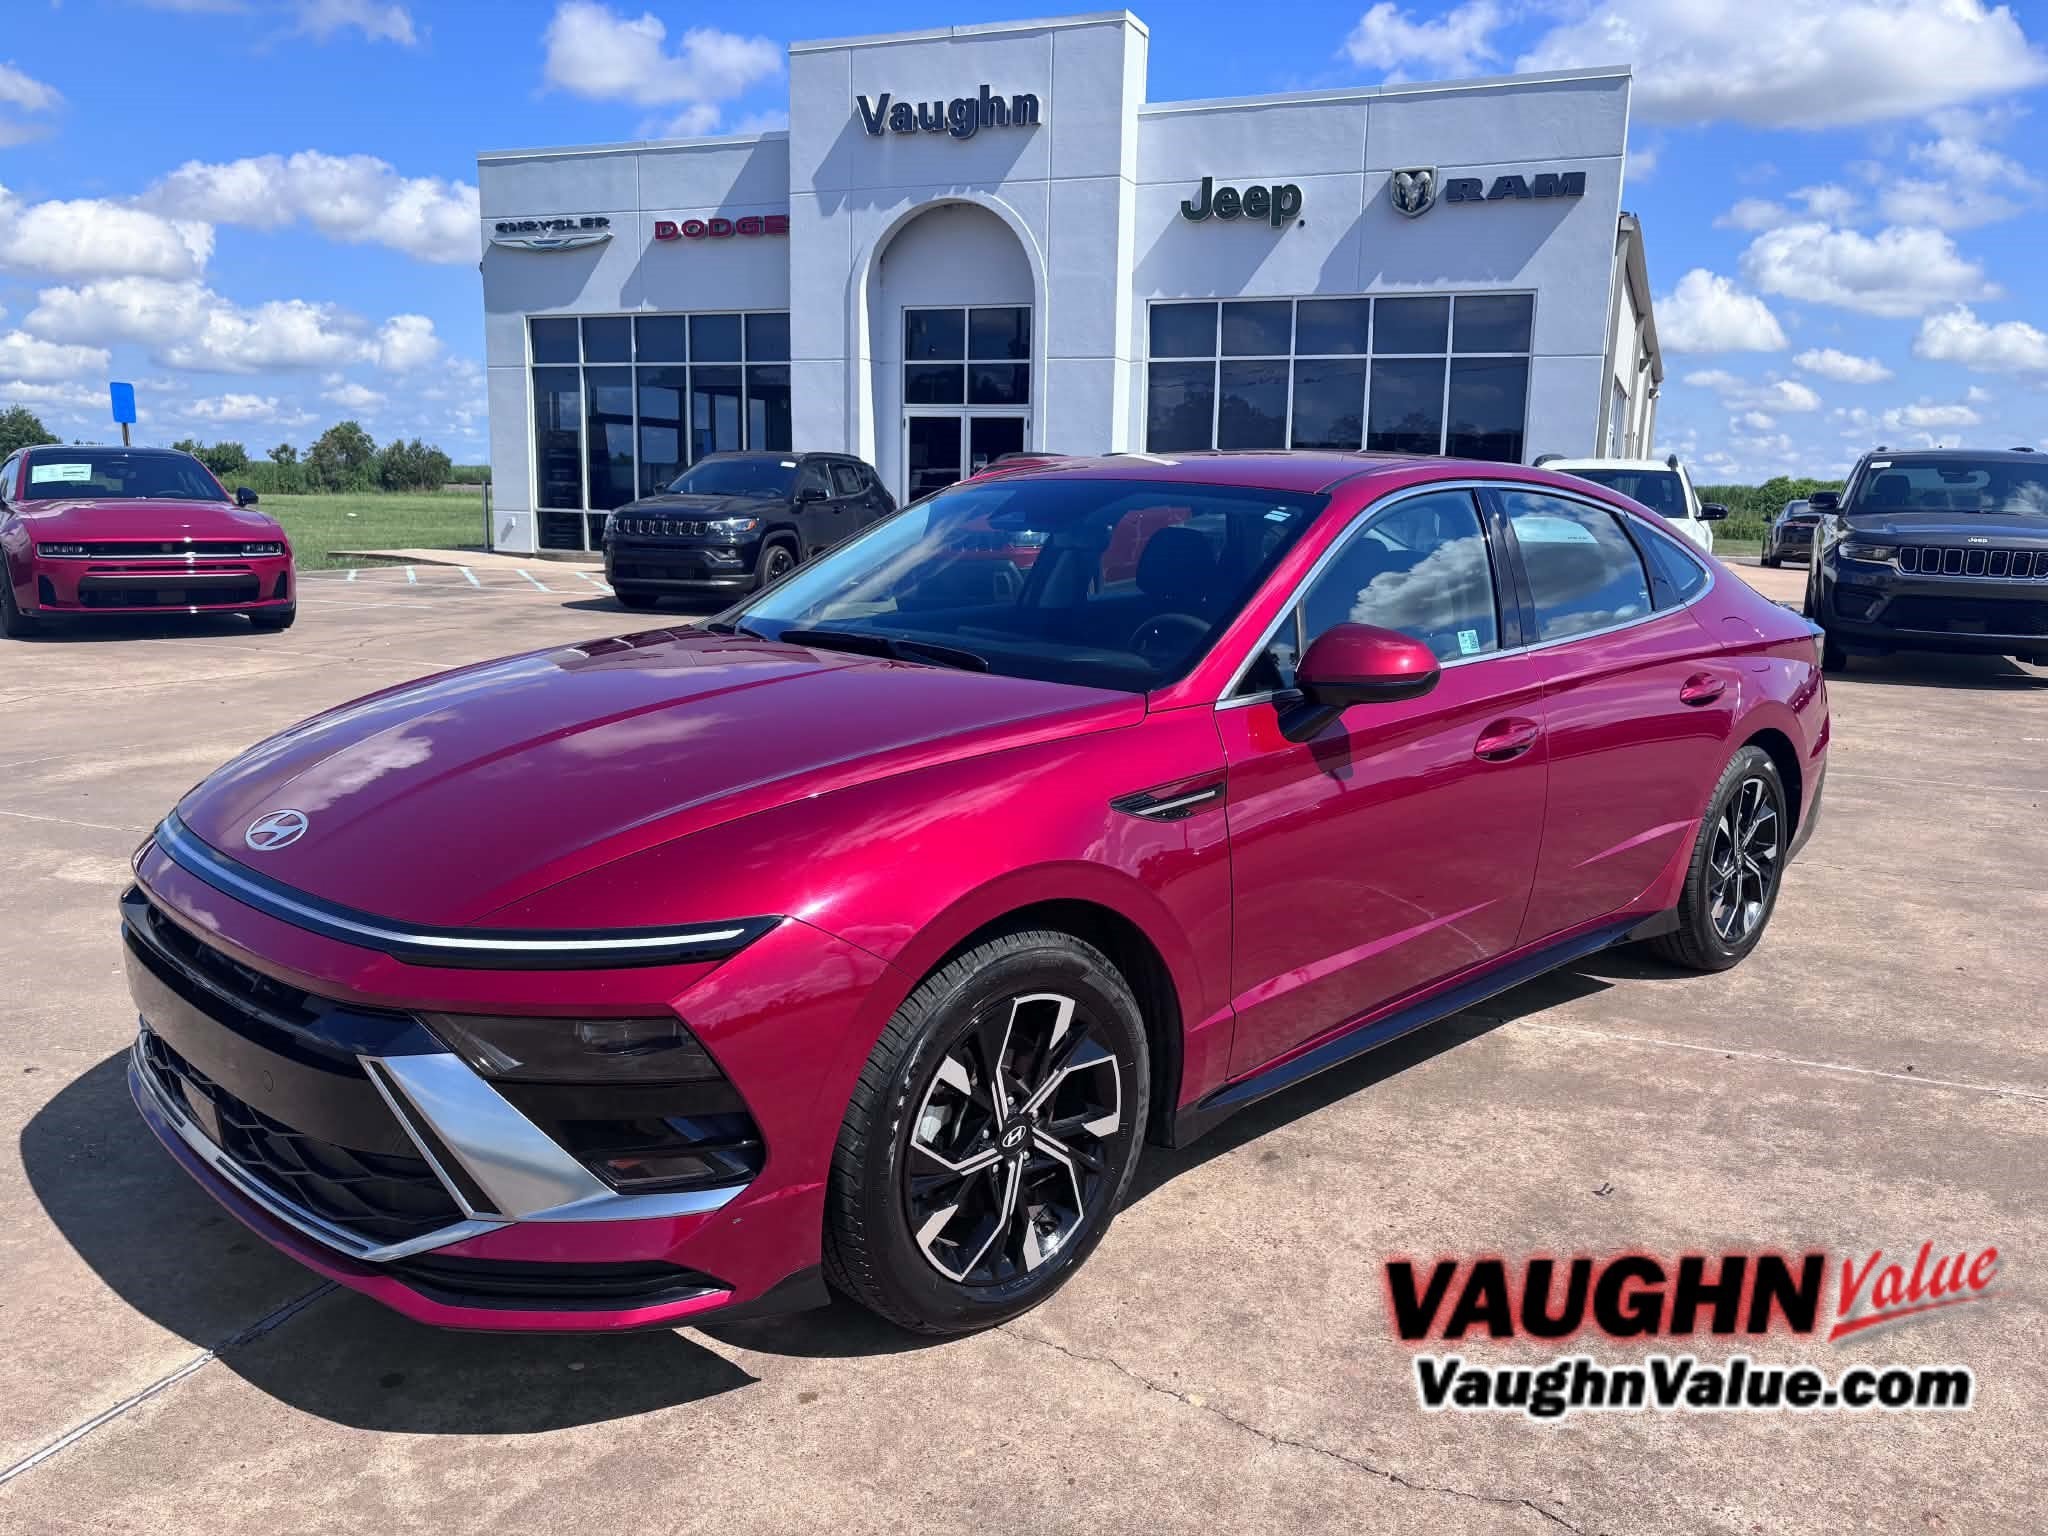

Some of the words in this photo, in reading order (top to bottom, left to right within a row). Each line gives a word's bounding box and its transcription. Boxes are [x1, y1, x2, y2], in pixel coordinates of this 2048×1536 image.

[856, 84, 1042, 139] Vaughn
[1180, 175, 1304, 228] Jeep
[1446, 171, 1586, 202] RAM
[654, 214, 790, 241] DODGE
